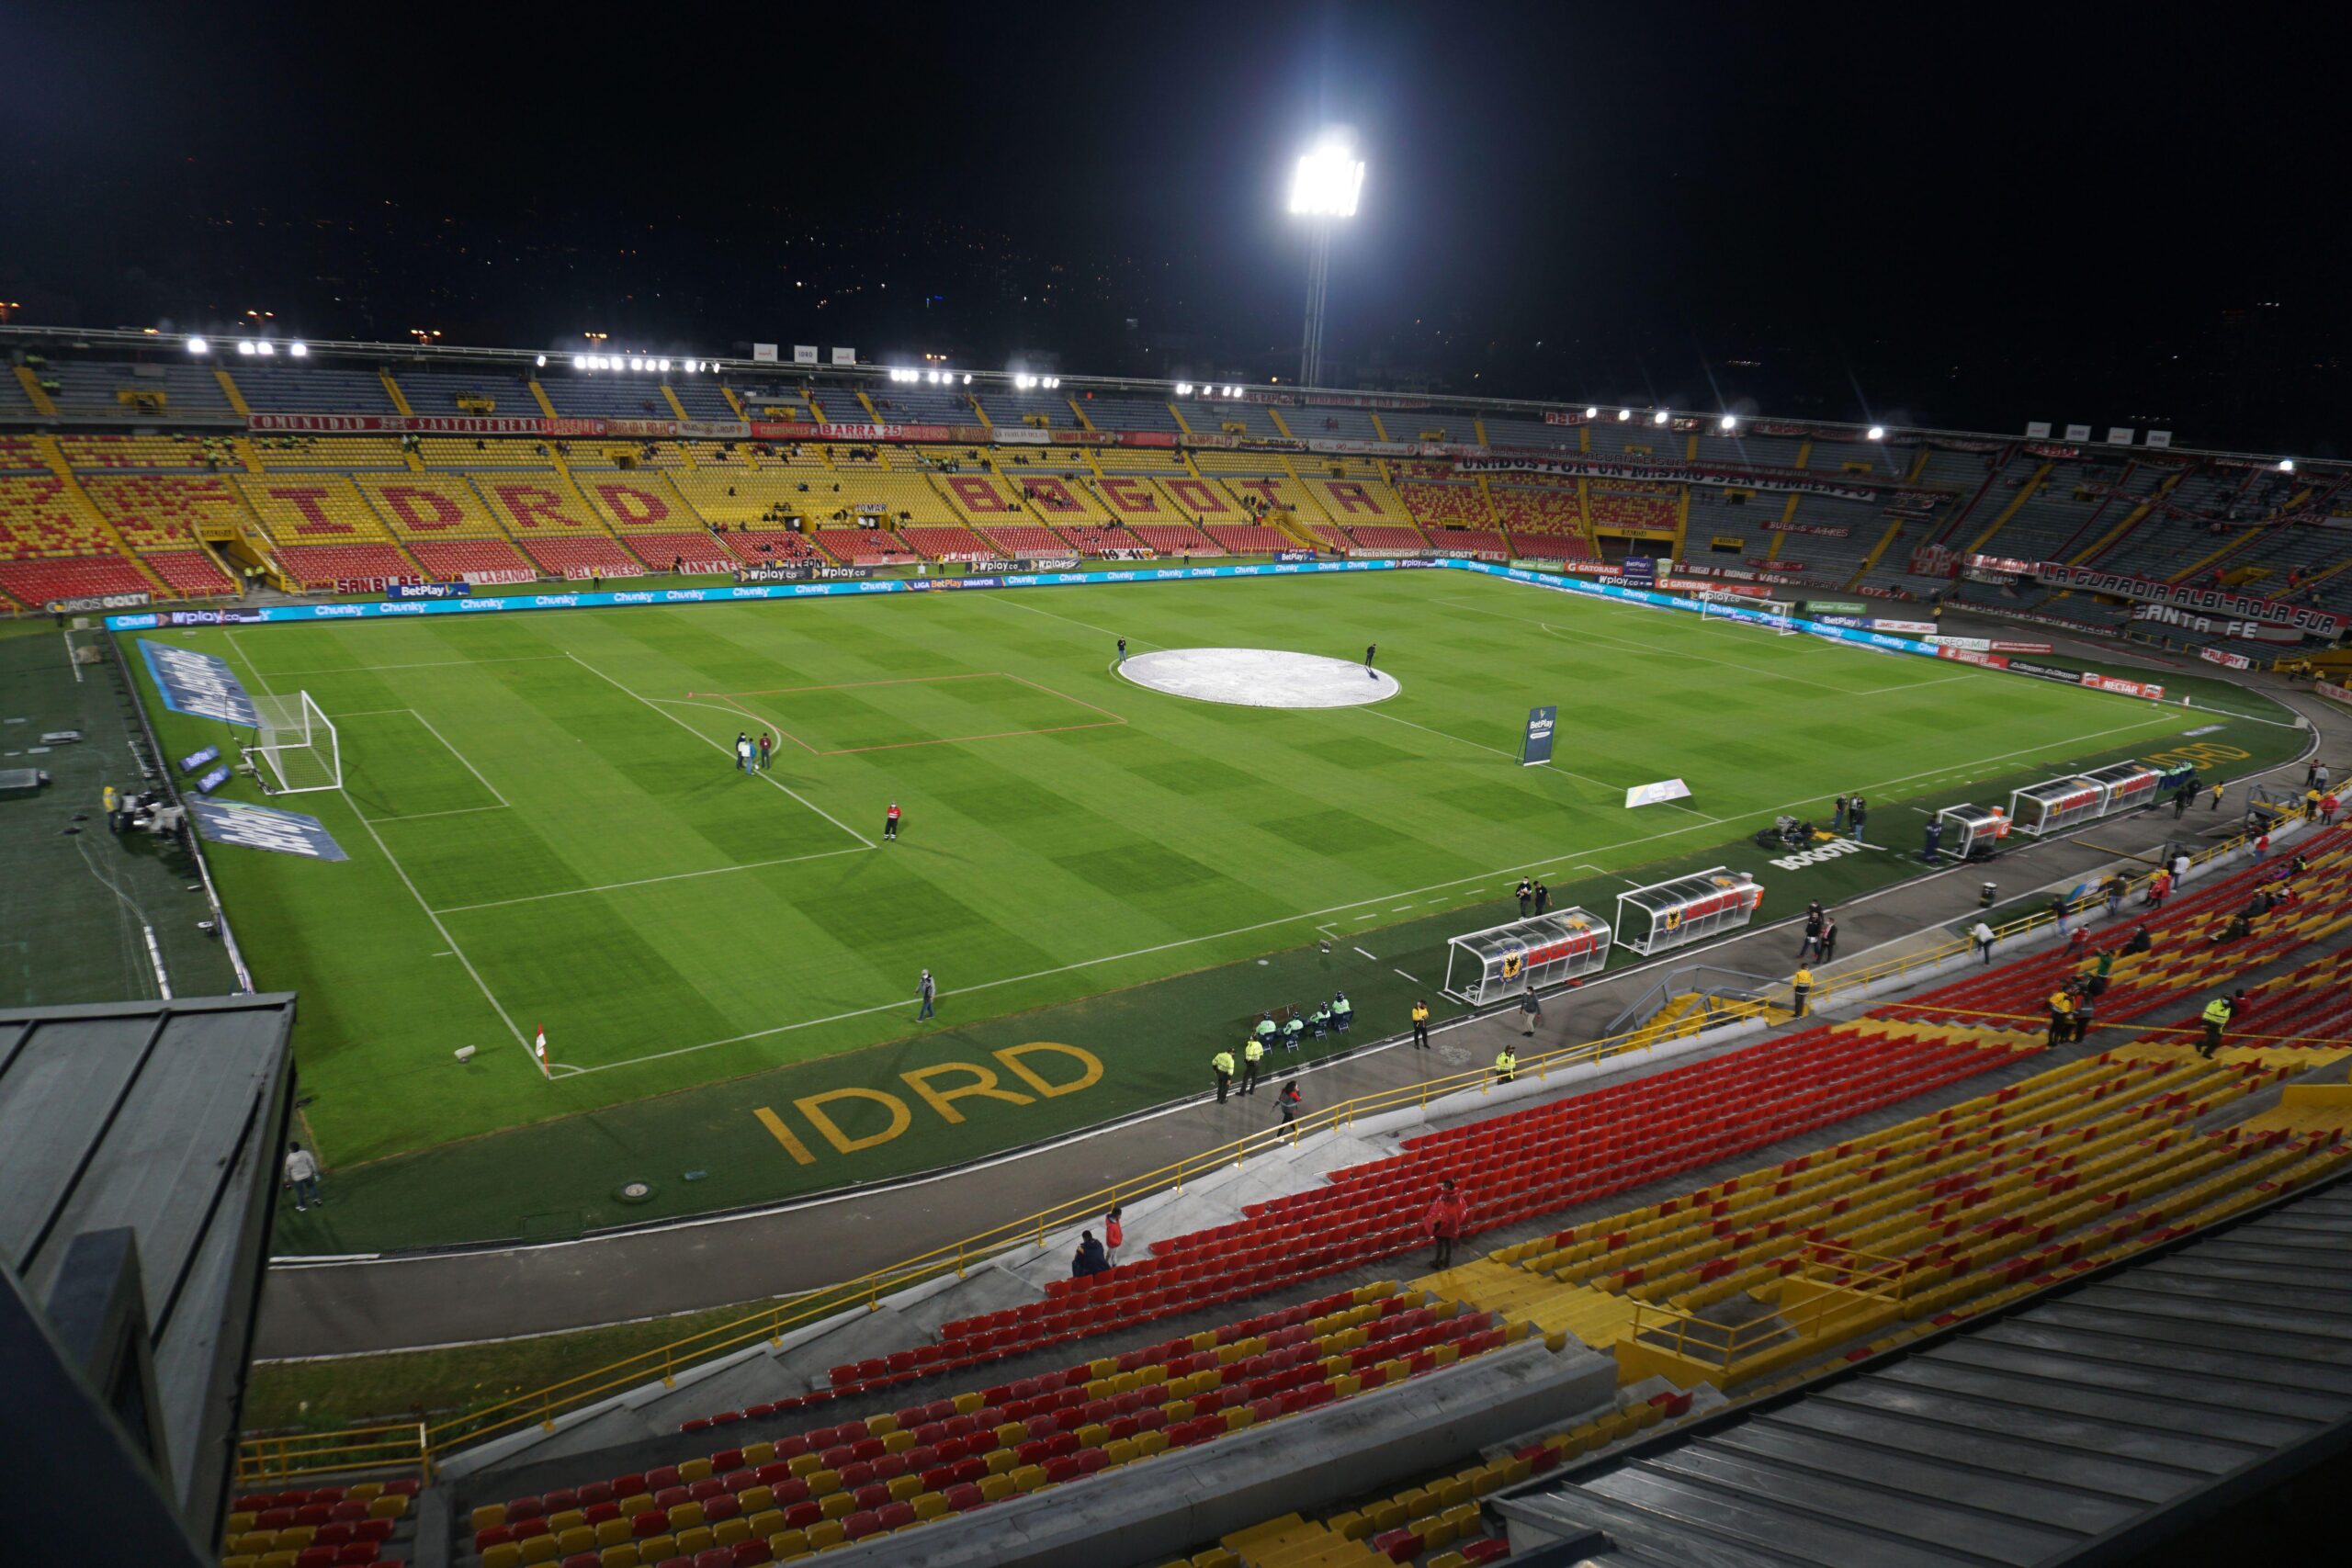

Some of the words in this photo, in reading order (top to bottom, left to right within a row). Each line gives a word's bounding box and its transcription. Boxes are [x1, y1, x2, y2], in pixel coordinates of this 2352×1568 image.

[248, 416, 366, 430] COMUNIDAD
[821, 424, 876, 435] BARRA
[883, 425, 901, 435] 25
[1462, 457, 1539, 470] UNIDOS
[1545, 460, 1589, 475] POR
[1598, 465, 1623, 476] UN
[1631, 465, 1706, 482] MISMO
[1713, 468, 1871, 498] SENTIMIENTO
[268, 484, 670, 534] IDRD
[1102, 549, 1119, 560] 19
[1449, 550, 1473, 559] GOLTY
[1234, 566, 1260, 576] Chunky
[1275, 564, 1299, 573] Chunky
[1317, 561, 1341, 571] Chunky
[1347, 560, 1371, 570] Chunky
[1467, 560, 1490, 572] Chunky
[1578, 564, 1619, 574] GATORADE
[496, 569, 536, 584] BANDA
[567, 567, 587, 580] DEL
[1058, 572, 1091, 583] Chunky
[1107, 570, 1136, 581] Chunky
[1157, 569, 1184, 579] Chunky
[1191, 568, 1217, 577] Chunky
[1508, 568, 1532, 581] Chunky
[1673, 564, 1686, 573] TE
[1690, 566, 1709, 575] SIGO
[1713, 568, 1721, 576] A
[1724, 570, 1755, 581] DONDE
[1758, 573, 1779, 583] VAS
[931, 580, 963, 590] BetPlay
[963, 579, 994, 588] DIMAYOR
[1008, 574, 1038, 585] Chunky
[1538, 573, 1563, 586] Chunky
[1598, 575, 1639, 586] Wplay.co
[337, 578, 370, 594] SAN
[401, 584, 446, 597] BetPlay
[732, 585, 772, 598] Chunky
[795, 583, 834, 595] Chunky
[859, 580, 895, 592] Chunky
[1579, 580, 1606, 593] Chunky
[1670, 581, 1713, 591] GATORADE
[102, 593, 150, 607] GOLTY
[535, 594, 579, 607] Chunky
[613, 591, 655, 604] Chunky
[665, 589, 706, 601] Chunky
[1623, 588, 1650, 602] Chunky
[2042, 565, 2071, 583] LA
[2074, 571, 2171, 602] GUARDIA
[2174, 587, 2292, 624] ALBI-ROJA
[2292, 608, 2337, 635] SUR
[314, 604, 366, 616] Chunky
[379, 602, 427, 614] Chunky
[459, 597, 504, 611] Chunky
[1671, 597, 1702, 611] Chunky
[1824, 615, 1857, 627] BetPlay
[2131, 604, 2212, 633] SANTA
[2225, 620, 2260, 639] FE
[1811, 622, 1845, 637] Chunky
[1871, 633, 1908, 649] Chunky
[2103, 680, 2139, 694] NECTAR
[1530, 719, 1554, 730] BetPlay
[753, 1041, 1104, 1166] IDRD
